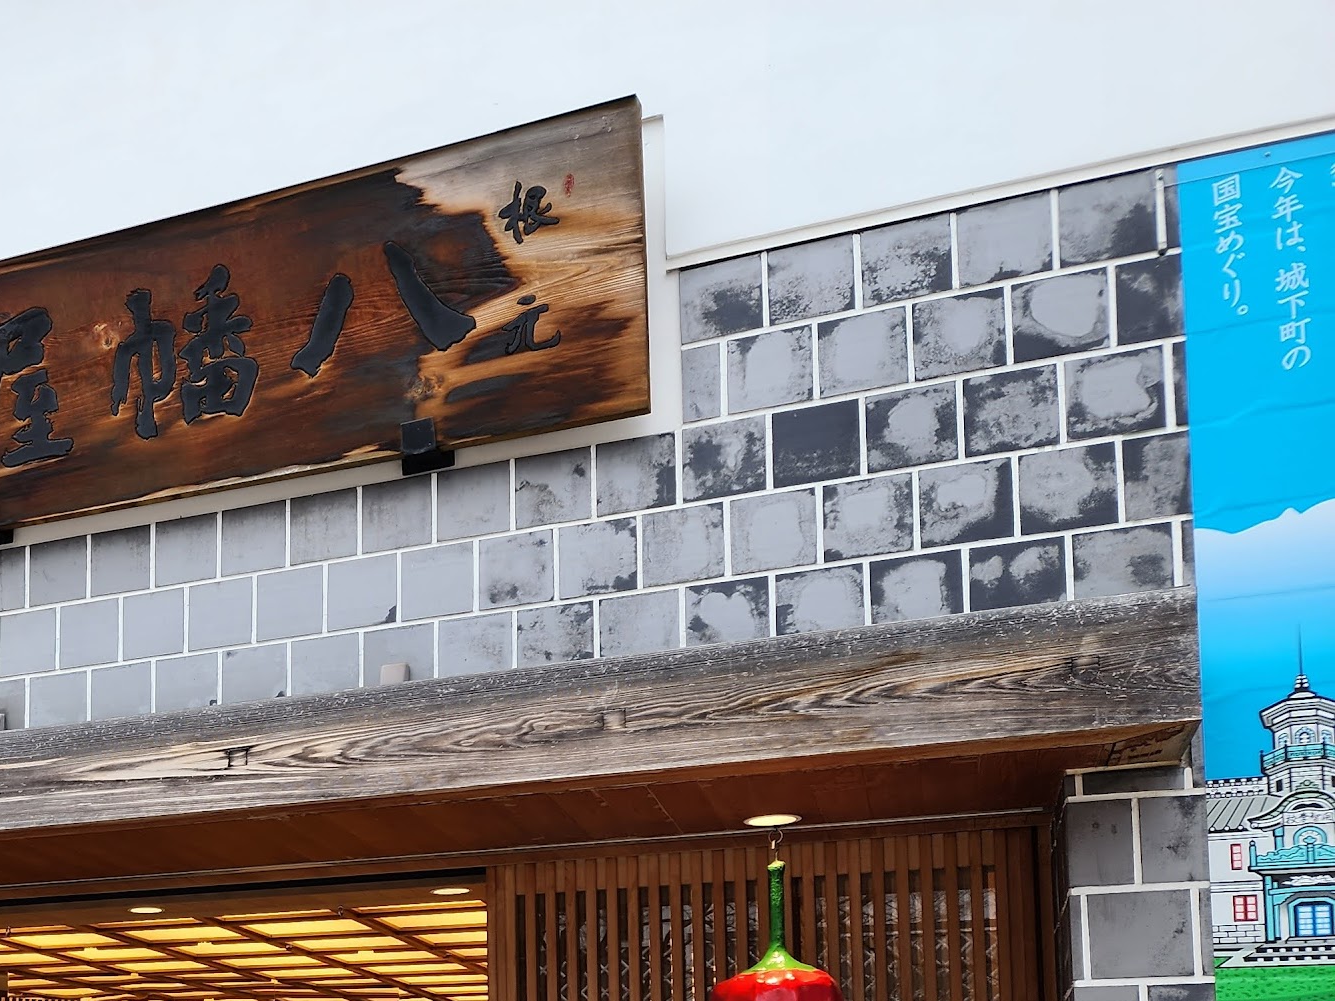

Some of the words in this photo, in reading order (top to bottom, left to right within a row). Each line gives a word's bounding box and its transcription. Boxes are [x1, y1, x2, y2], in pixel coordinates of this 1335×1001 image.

[498, 181, 561, 354] 根元
[1212, 173, 1249, 316] 国宝めぐり。
[1269, 166, 1312, 371] 今年は、城下町の
